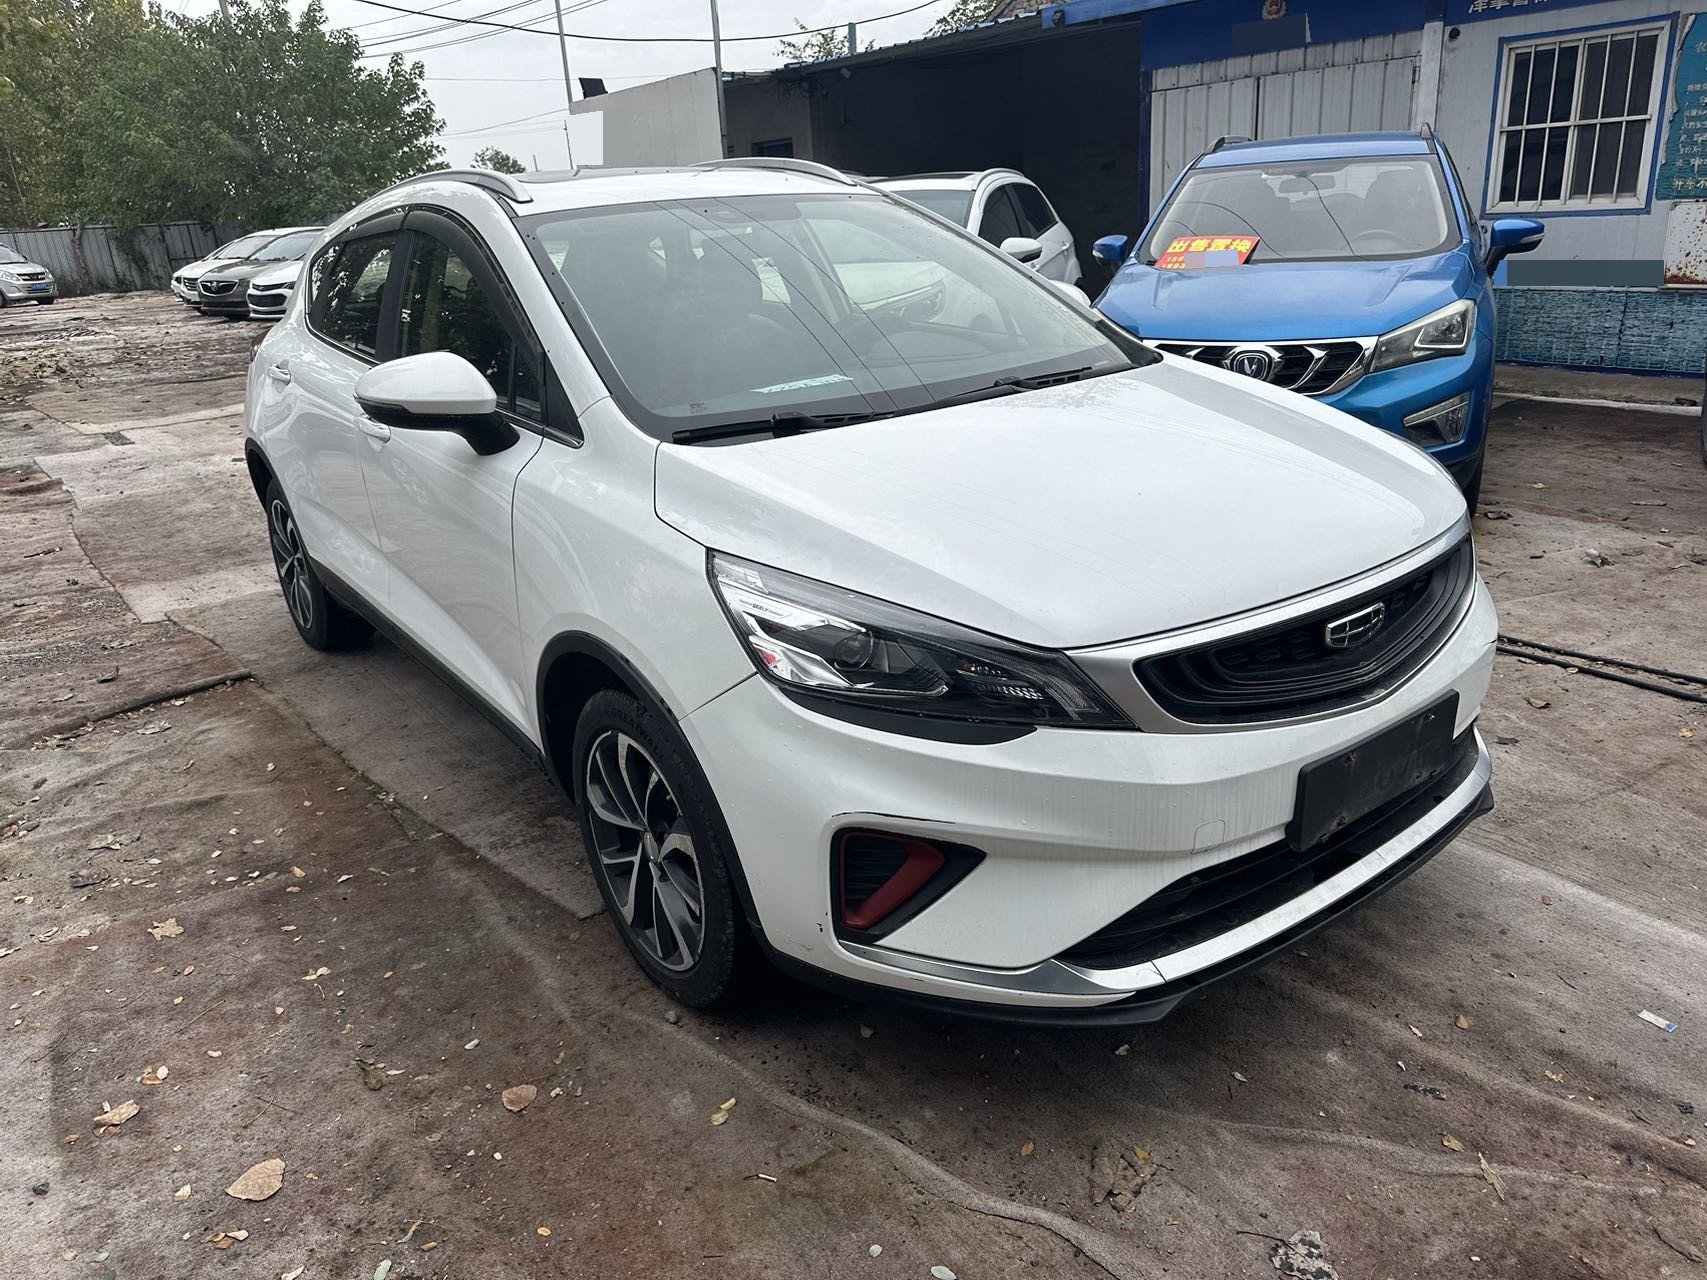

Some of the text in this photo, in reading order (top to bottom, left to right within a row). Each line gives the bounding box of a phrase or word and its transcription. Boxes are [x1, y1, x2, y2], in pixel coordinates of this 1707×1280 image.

[1167, 239, 1252, 253] 出售置换
[752, 603, 769, 613] GEELY
